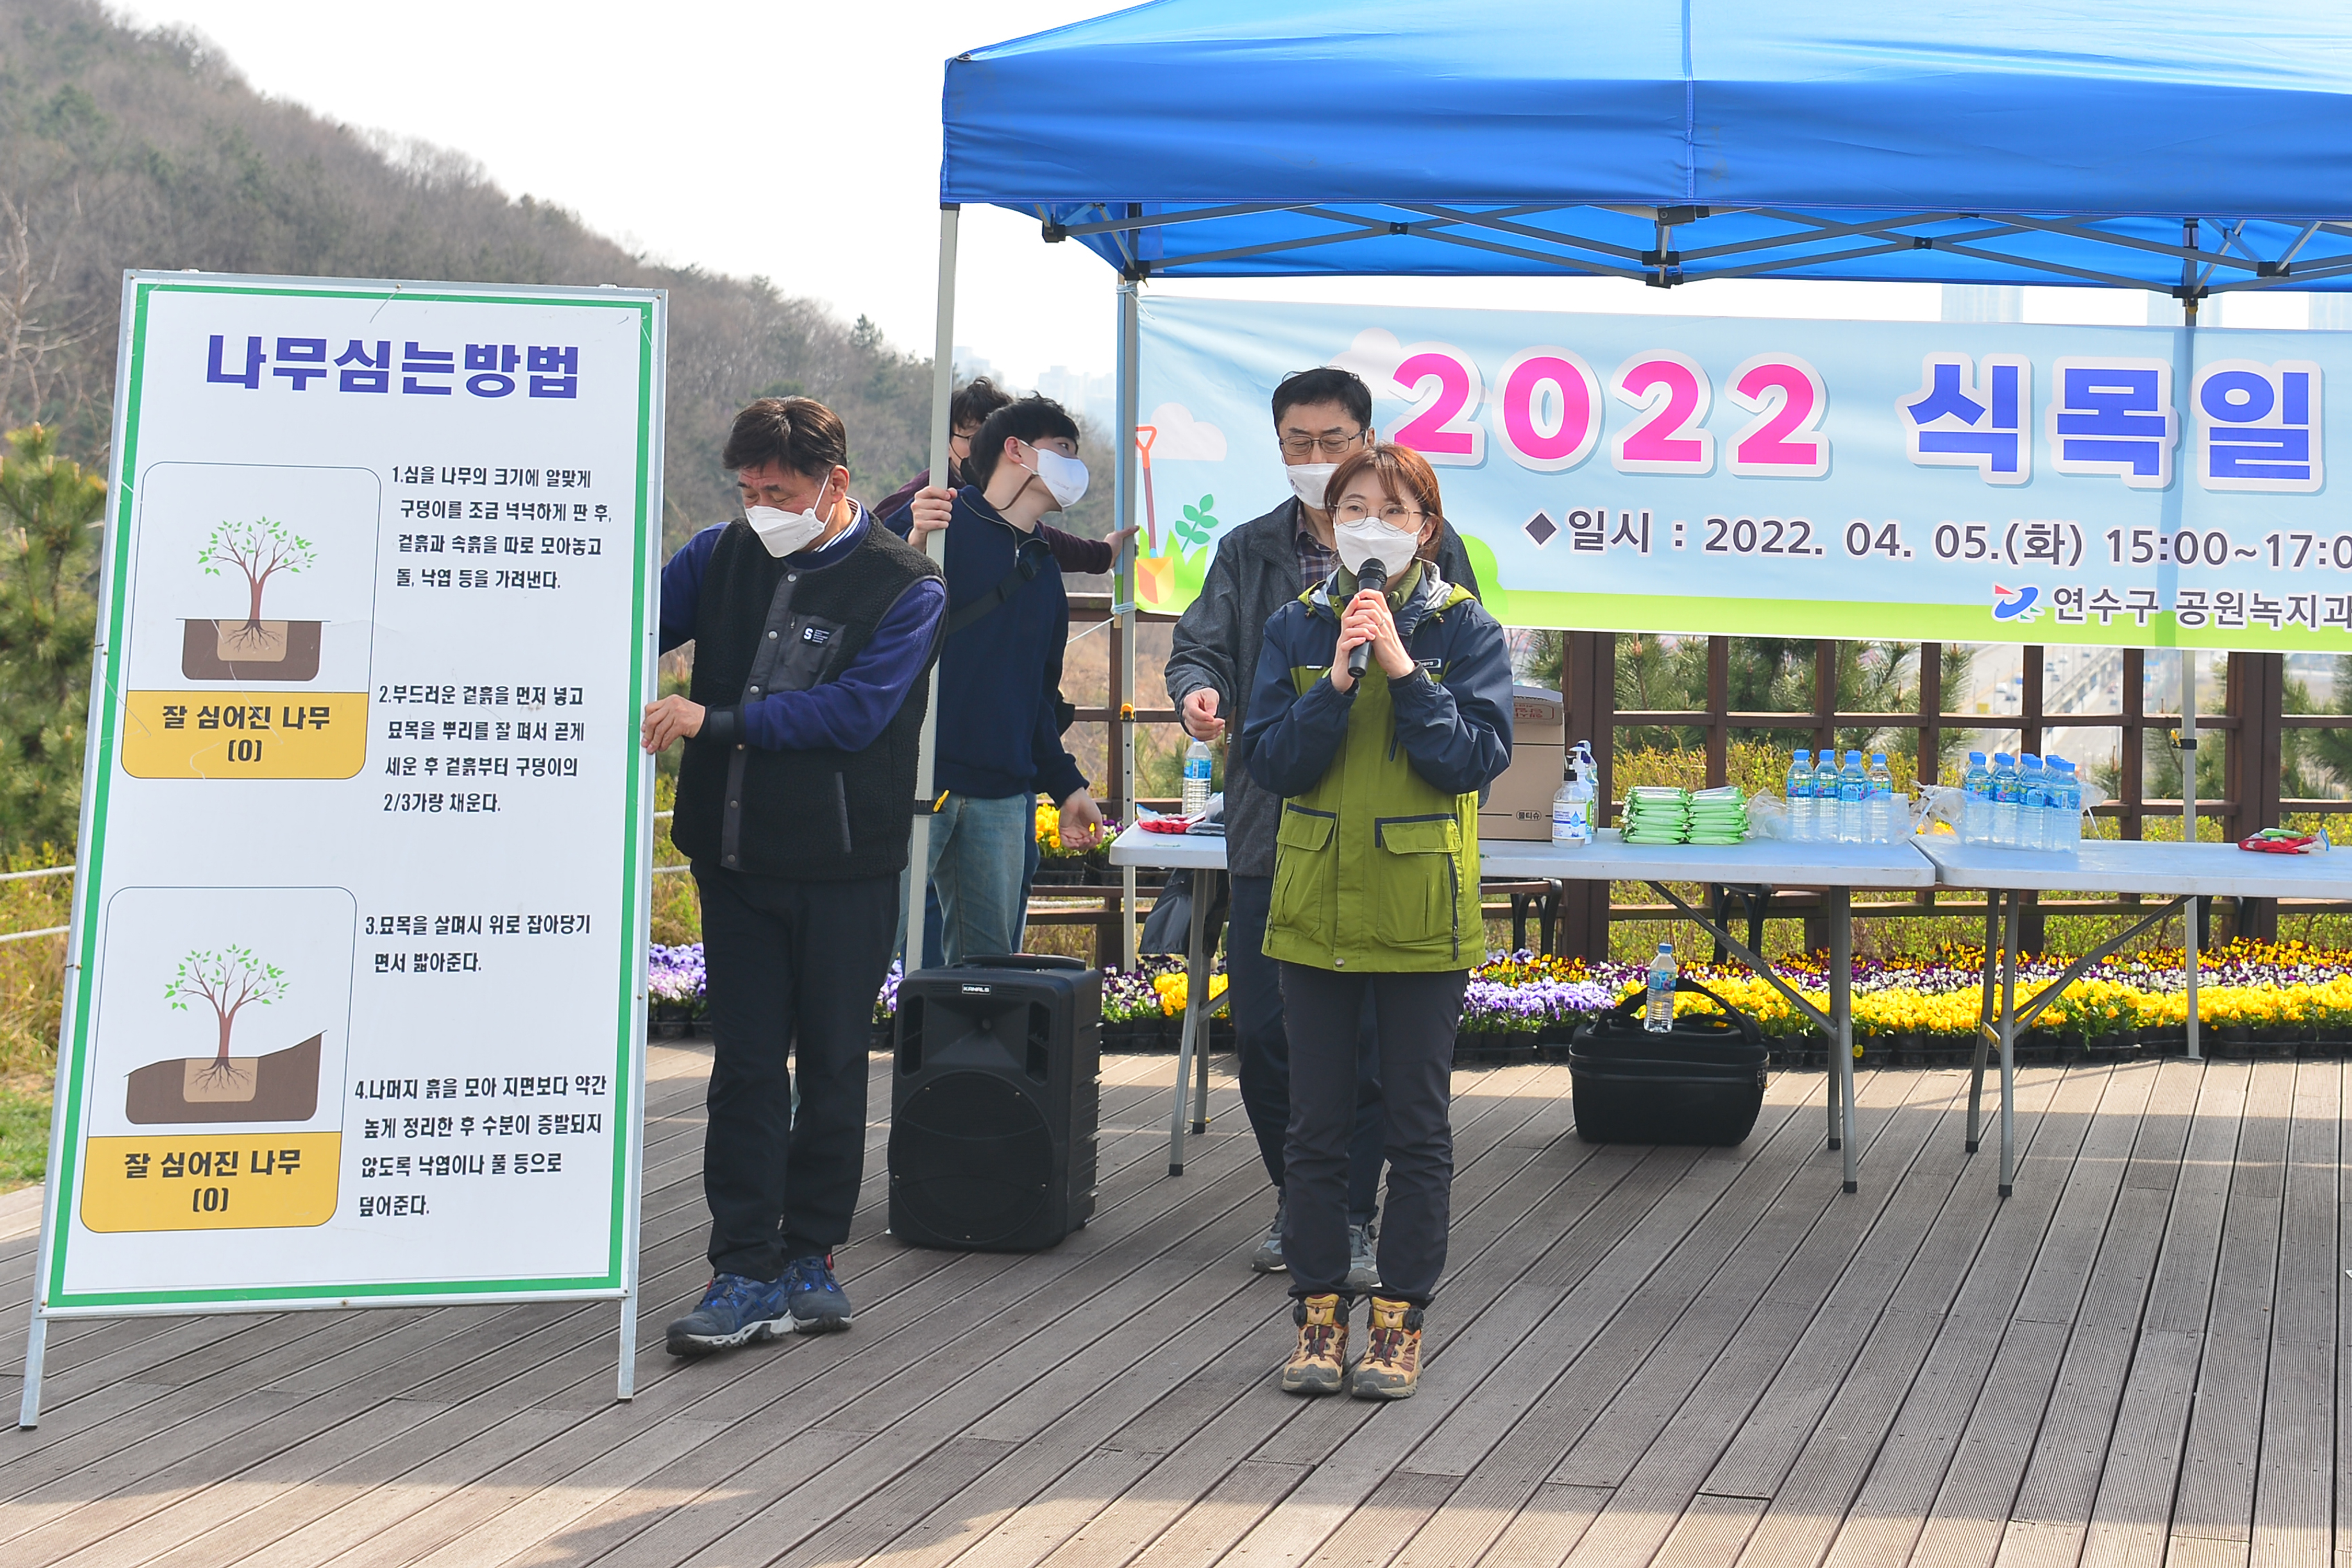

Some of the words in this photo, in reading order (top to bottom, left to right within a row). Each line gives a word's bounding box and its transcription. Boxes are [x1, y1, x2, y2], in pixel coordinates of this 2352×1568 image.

[206, 335, 579, 399] 나무심는방법
[1392, 352, 1818, 465] 2022
[1906, 363, 2310, 480] 식목일
[393, 466, 434, 484] 1.심을
[442, 467, 487, 486] 나무의
[494, 468, 539, 487] 크기에
[546, 469, 591, 488] 알맞게
[400, 500, 462, 519] 구덩이를
[469, 502, 499, 520] 조금
[506, 502, 566, 522] 넉넉하게
[573, 504, 588, 522] 판
[594, 504, 611, 522] 후,
[399, 534, 445, 553] 겉흙과
[452, 535, 497, 554] 속흙을
[504, 536, 534, 554] 따로
[541, 537, 601, 556] 모아놓고
[1568, 510, 1651, 553] 일시
[1705, 518, 1823, 555] 2022.
[1846, 523, 1911, 558] 04.
[1935, 523, 2082, 566] 05.(화)
[397, 568, 414, 586] 돌,
[422, 569, 451, 587] 낙엽
[459, 570, 488, 588] 등을
[495, 570, 560, 589] 가려낸다.
[2054, 586, 2159, 623] 연수구
[804, 628, 813, 640] S
[379, 685, 455, 705] 2.부드러운
[516, 686, 546, 706] 먼저
[554, 687, 583, 706] 넣고
[163, 706, 188, 729] 잘
[197, 706, 271, 730] 심어진
[282, 706, 330, 730] 나무
[388, 721, 435, 740] 묘목을
[442, 721, 488, 740] 뿌리를
[495, 722, 511, 741] 잘
[517, 722, 547, 741] 펴서
[555, 722, 584, 741] 곧게
[385, 757, 417, 776] 세운
[424, 757, 438, 776] 후
[446, 757, 508, 776] 겉흙부터
[516, 758, 578, 777] 구덩이의
[384, 793, 444, 813] 2/3가량
[449, 793, 501, 812] 채운다.
[365, 915, 428, 935] 3.묘목을
[489, 915, 520, 935] 위로
[527, 915, 590, 935] 잡아당기
[375, 953, 406, 973] 면서
[355, 1079, 418, 1100] 4.나머지
[426, 1078, 457, 1099] 흙을
[465, 1077, 497, 1098] 모아
[502, 1076, 569, 1097] 지면보다
[575, 1075, 607, 1096] 약간
[364, 1118, 396, 1139] 높게
[403, 1116, 453, 1138] 정리한
[460, 1116, 475, 1136] 후
[482, 1115, 530, 1136] 수분이
[538, 1113, 601, 1135] 증발되지
[124, 1153, 151, 1179] 잘
[160, 1151, 238, 1178] 심어진
[250, 1149, 301, 1175] 나무
[362, 1156, 411, 1178] 않도록
[419, 1155, 485, 1176] 낙엽이나
[492, 1154, 506, 1174] 풀
[514, 1153, 561, 1174] 등으로
[360, 1195, 429, 1217] 덮어준다.
